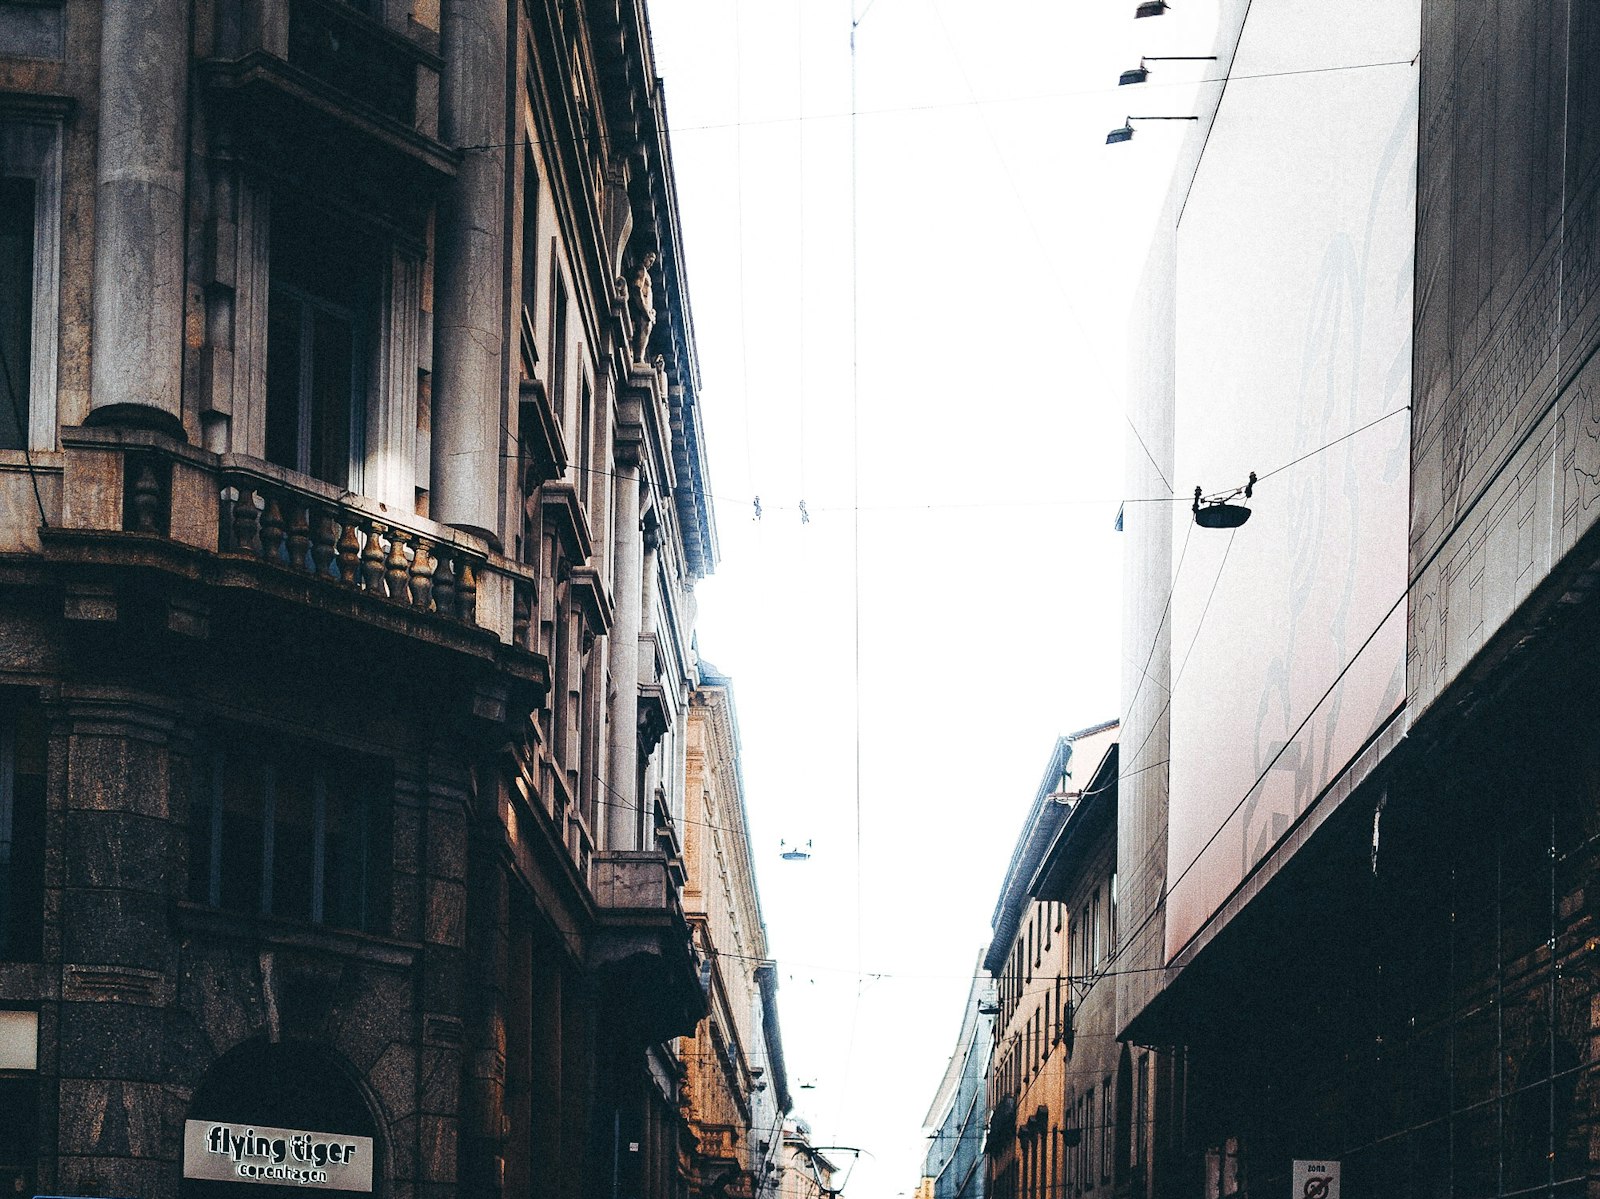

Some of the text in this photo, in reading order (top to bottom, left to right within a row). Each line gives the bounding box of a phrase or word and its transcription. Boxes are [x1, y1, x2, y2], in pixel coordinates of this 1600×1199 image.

[206, 1125, 356, 1169] flying tiger
[236, 1163, 328, 1184] copenhagen
